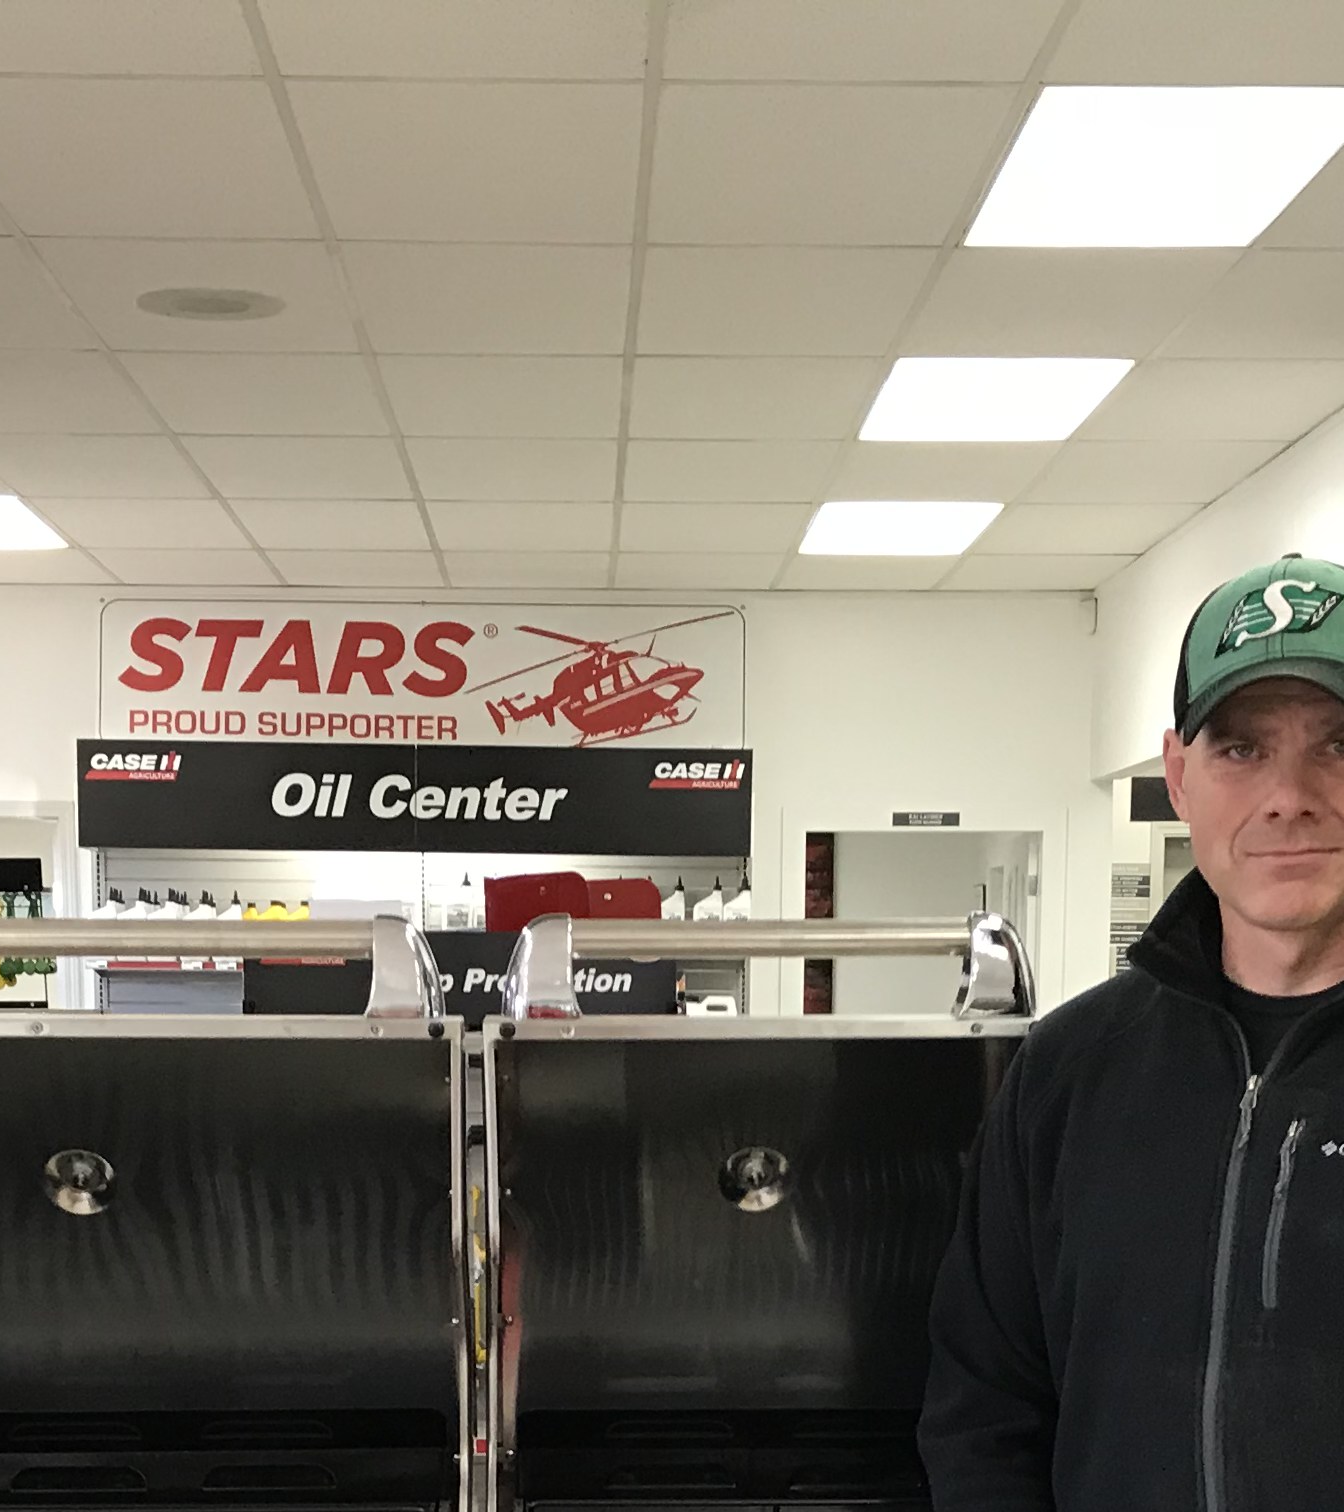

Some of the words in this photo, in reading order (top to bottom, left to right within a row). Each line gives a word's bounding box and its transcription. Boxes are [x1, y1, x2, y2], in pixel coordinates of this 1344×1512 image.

[118, 618, 476, 698] STARS
[129, 710, 246, 735] PROUD
[258, 712, 458, 741] SUPPORTER
[90, 753, 157, 771] CASE
[654, 762, 721, 779] CASE
[271, 772, 353, 818] Oil
[368, 774, 568, 821] Center
